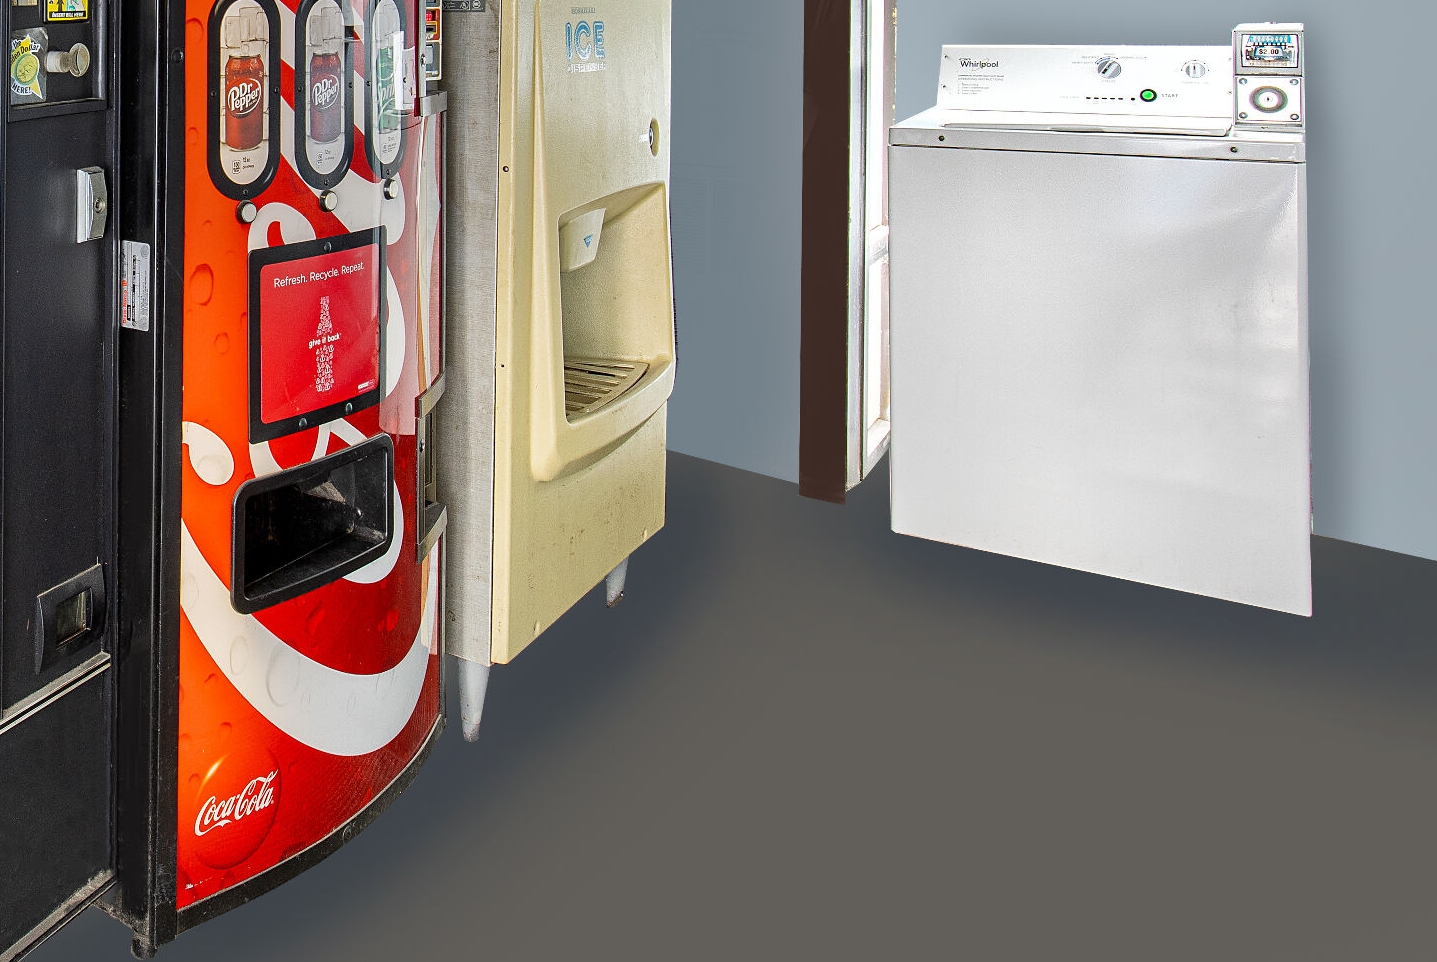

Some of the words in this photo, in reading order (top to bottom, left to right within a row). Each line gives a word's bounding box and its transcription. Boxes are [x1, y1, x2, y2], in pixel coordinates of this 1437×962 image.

[565, 20, 605, 61] ICE
[960, 60, 999, 69] Whirlpool
[12, 83, 31, 95] HERE!
[239, 82, 253, 94] Dr
[313, 81, 339, 106] Pepper
[322, 78, 333, 89] Dr
[228, 83, 261, 112] Pepper
[273, 274, 308, 289] Refresh.
[309, 267, 340, 282] Recycle.
[341, 261, 365, 275] Repeat.
[308, 339, 322, 349] give
[327, 332, 340, 343] back
[194, 769, 279, 836] Coca-Cola
